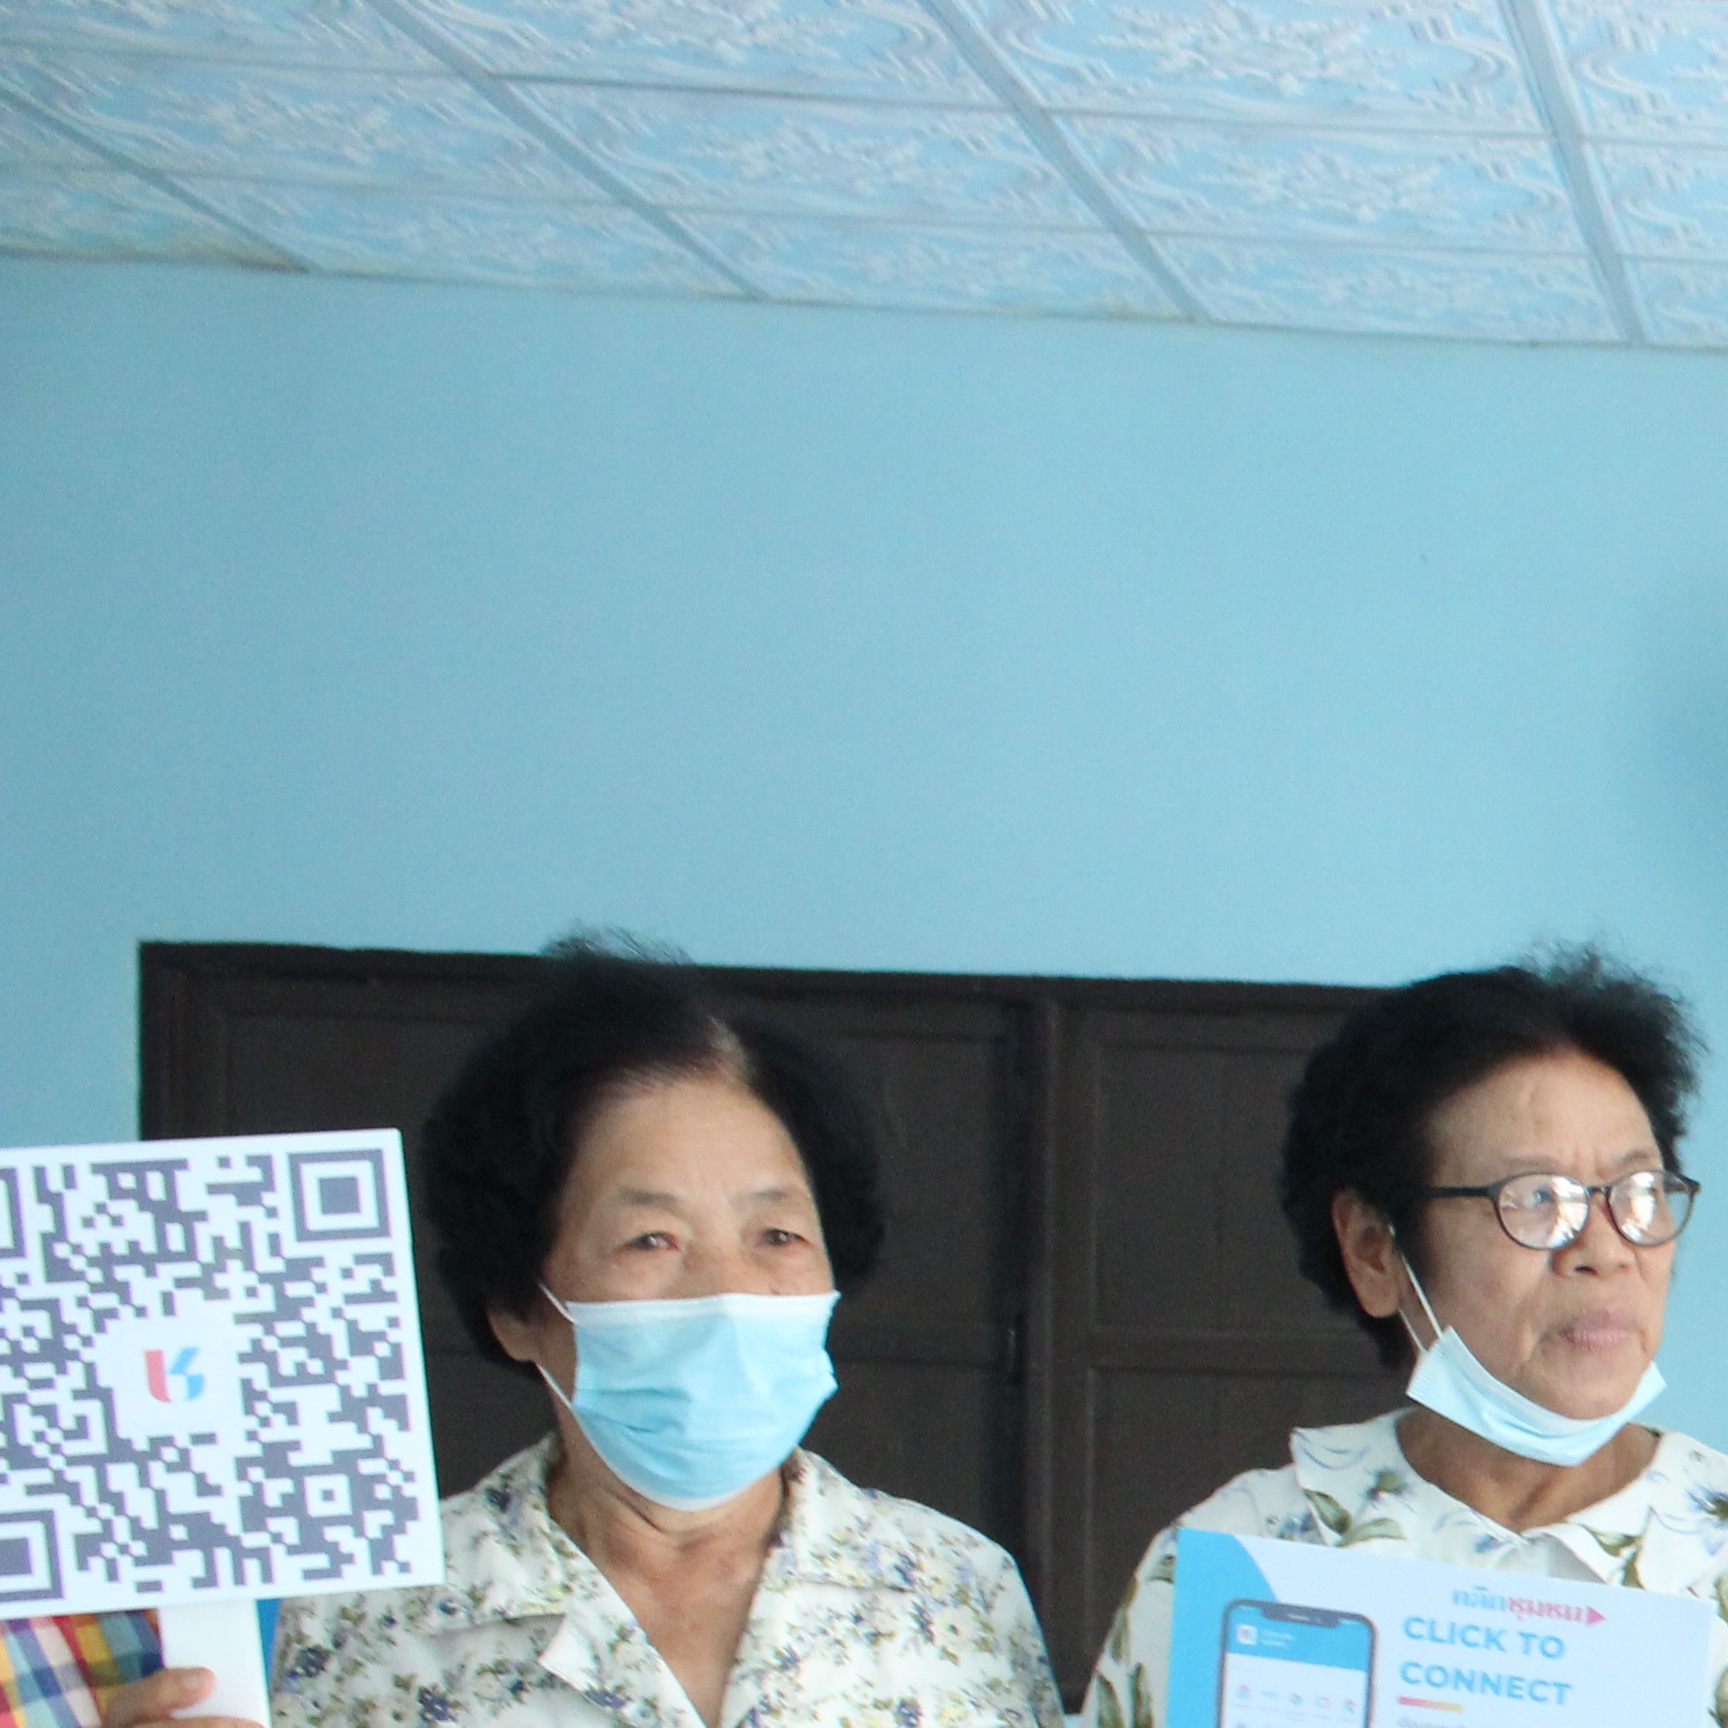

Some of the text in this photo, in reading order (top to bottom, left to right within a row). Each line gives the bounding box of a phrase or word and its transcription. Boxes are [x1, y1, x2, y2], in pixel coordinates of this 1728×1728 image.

[1403, 1615, 1566, 1661] CLICK TO
[1399, 1659, 1573, 1706] CONNECT
